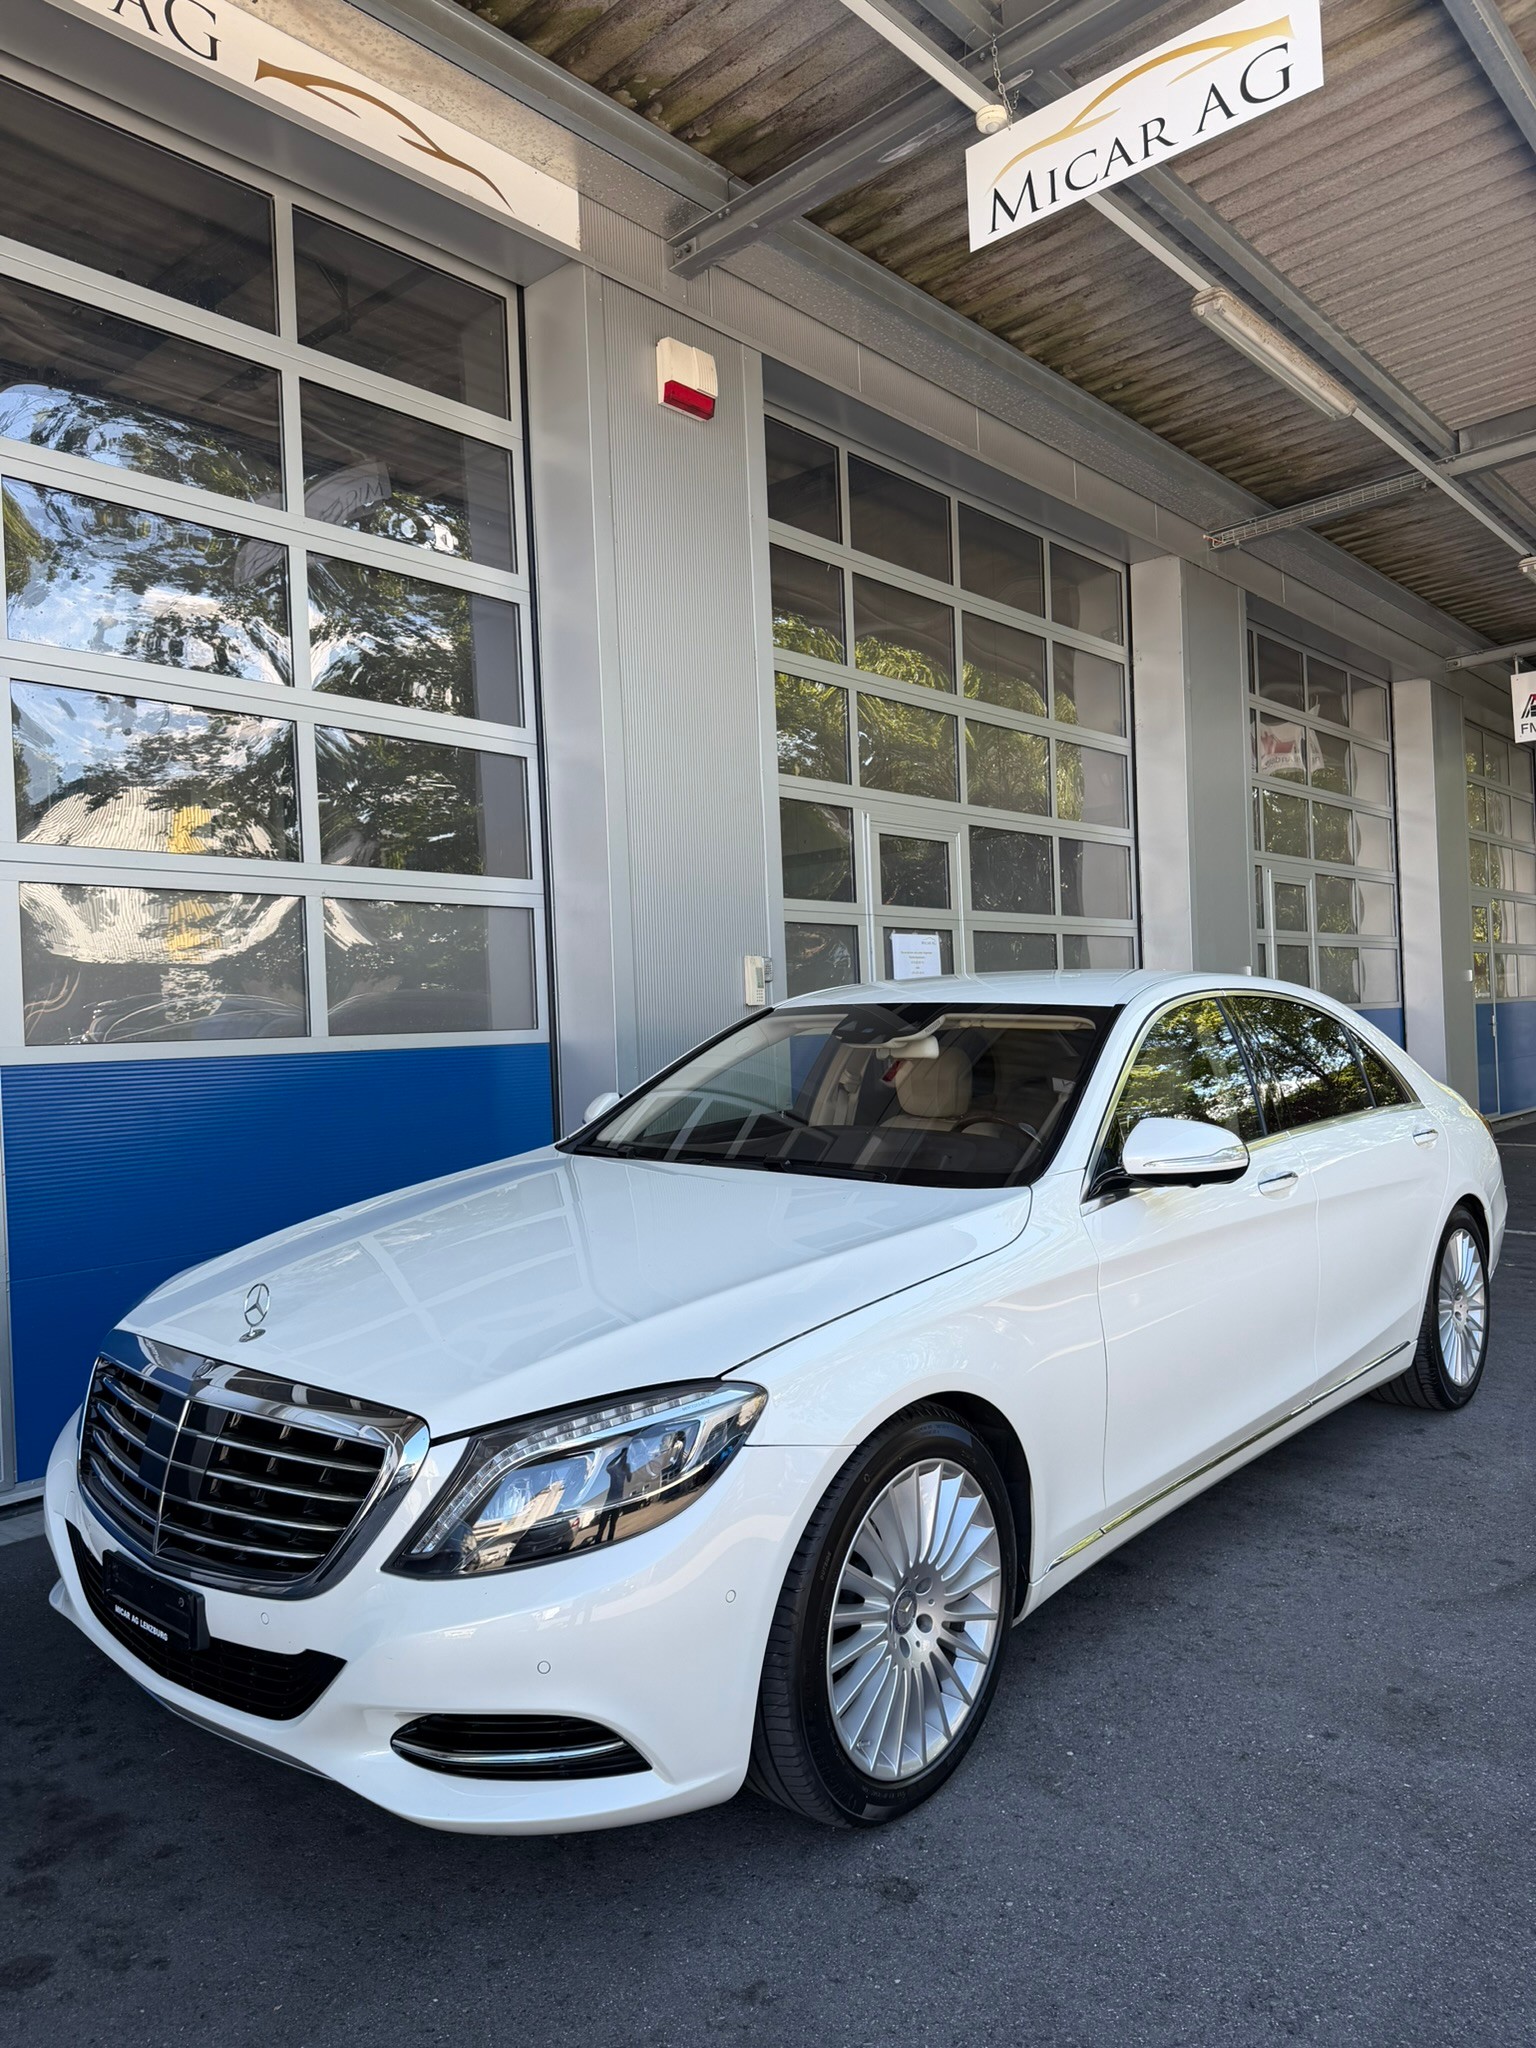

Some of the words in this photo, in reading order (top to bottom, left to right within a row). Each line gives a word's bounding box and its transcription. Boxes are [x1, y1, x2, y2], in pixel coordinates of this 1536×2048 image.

[987, 116, 1179, 234] MICAR
[1192, 42, 1295, 136] AG
[114, 1604, 131, 1621] MICAR
[131, 1614, 139, 1625] AG
[140, 1619, 168, 1641] LENZBURG
